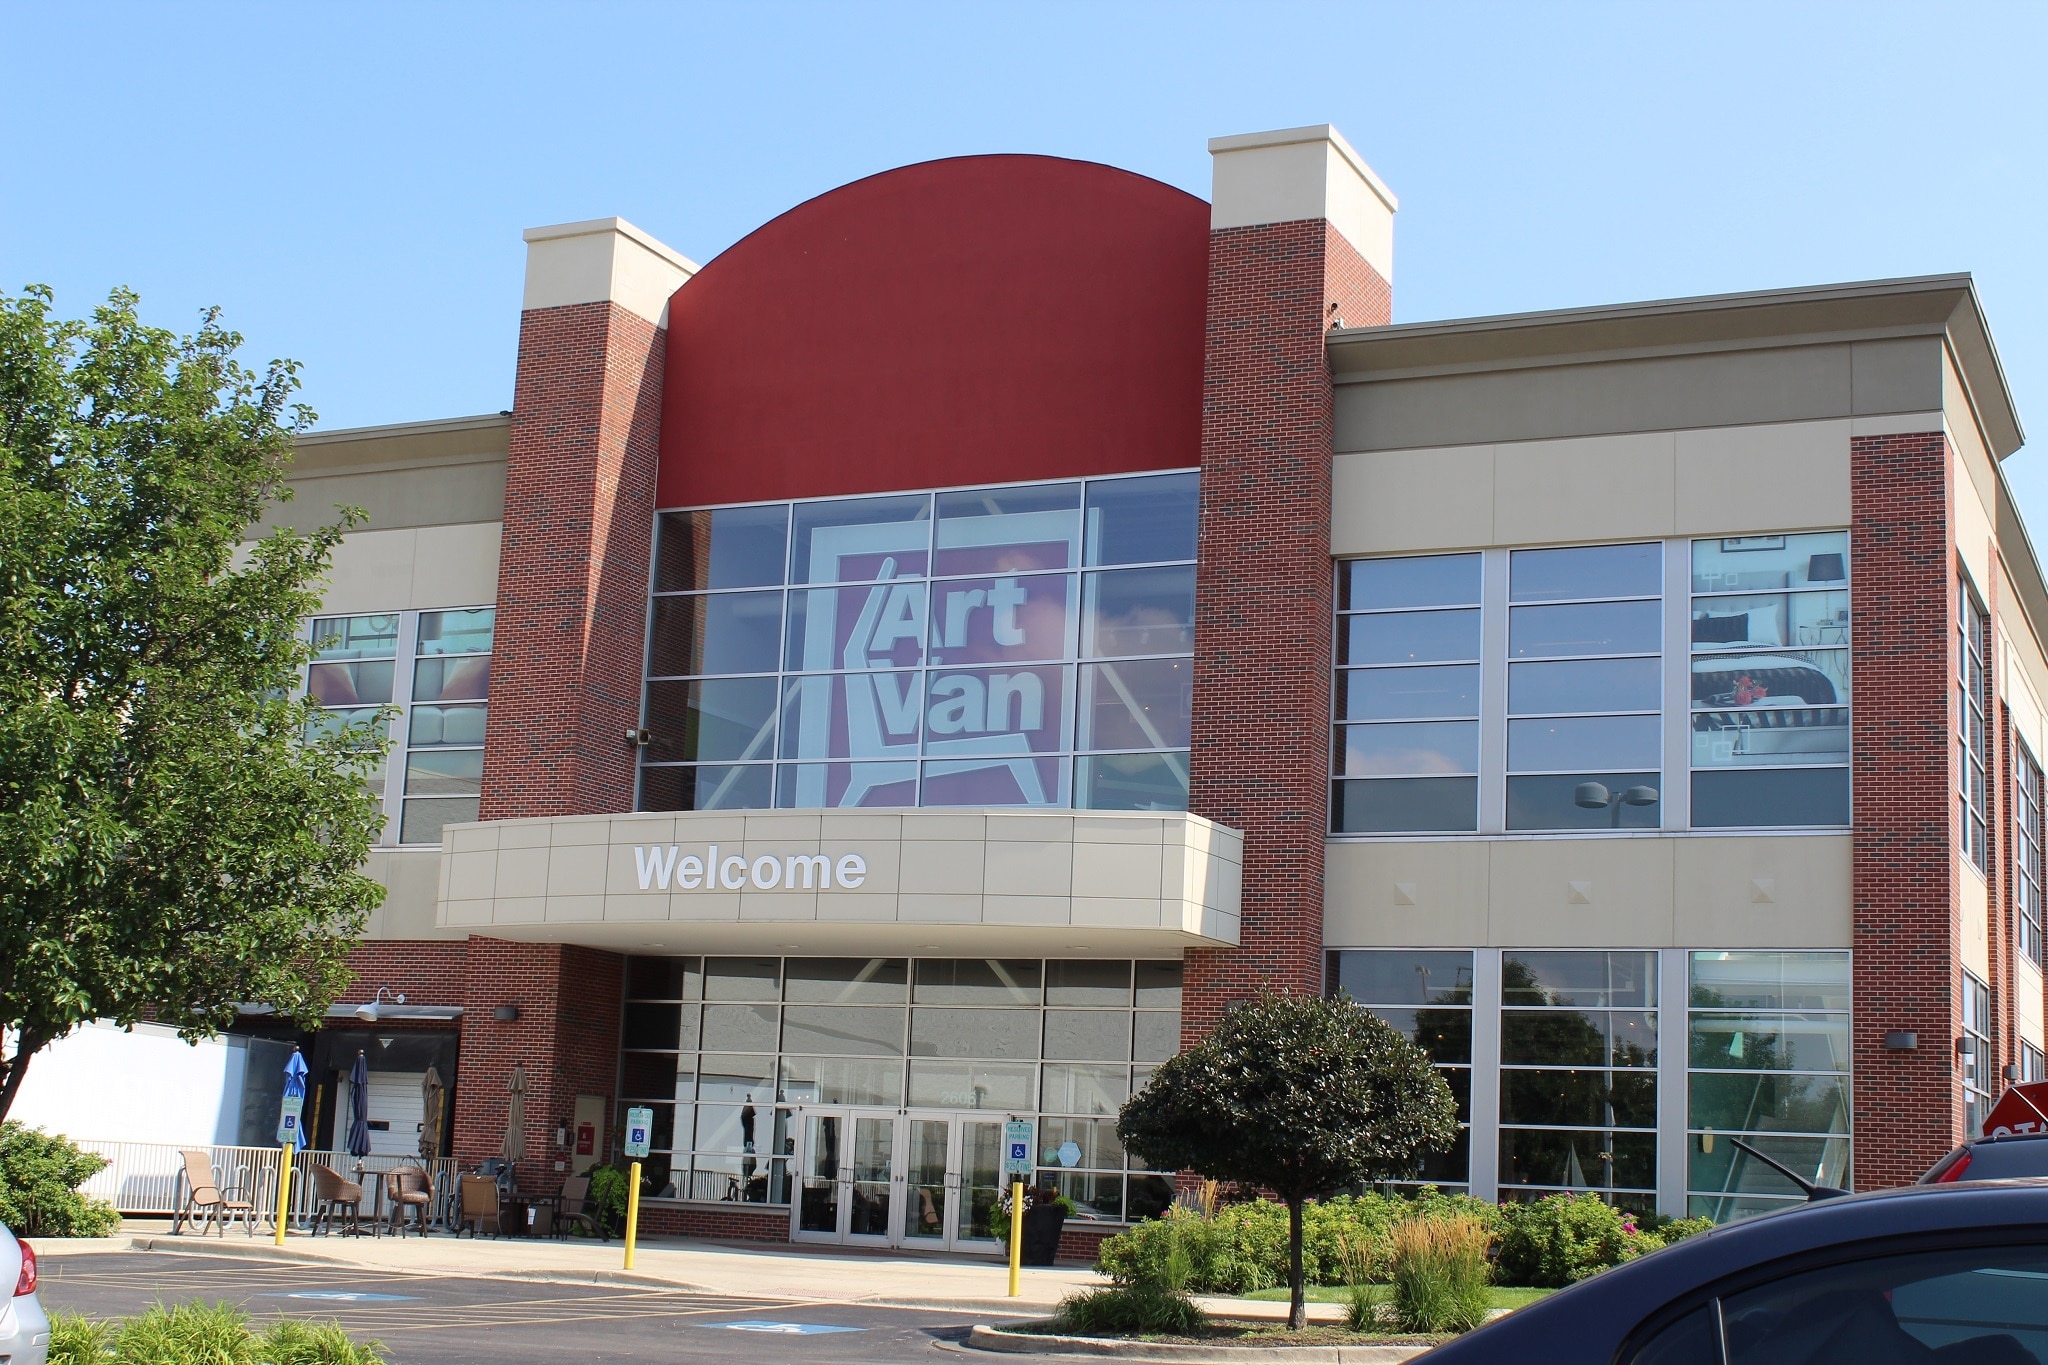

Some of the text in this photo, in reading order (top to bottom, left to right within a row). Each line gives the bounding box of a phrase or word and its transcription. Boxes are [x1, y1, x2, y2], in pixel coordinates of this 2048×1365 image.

[868, 568, 1027, 652] Art
[868, 656, 1045, 736] Van
[634, 845, 867, 890] Welcome
[940, 1090, 977, 1105] 2606
[1007, 1125, 1031, 1133] RESERVED
[1005, 1161, 1031, 1171] $250 FINE
